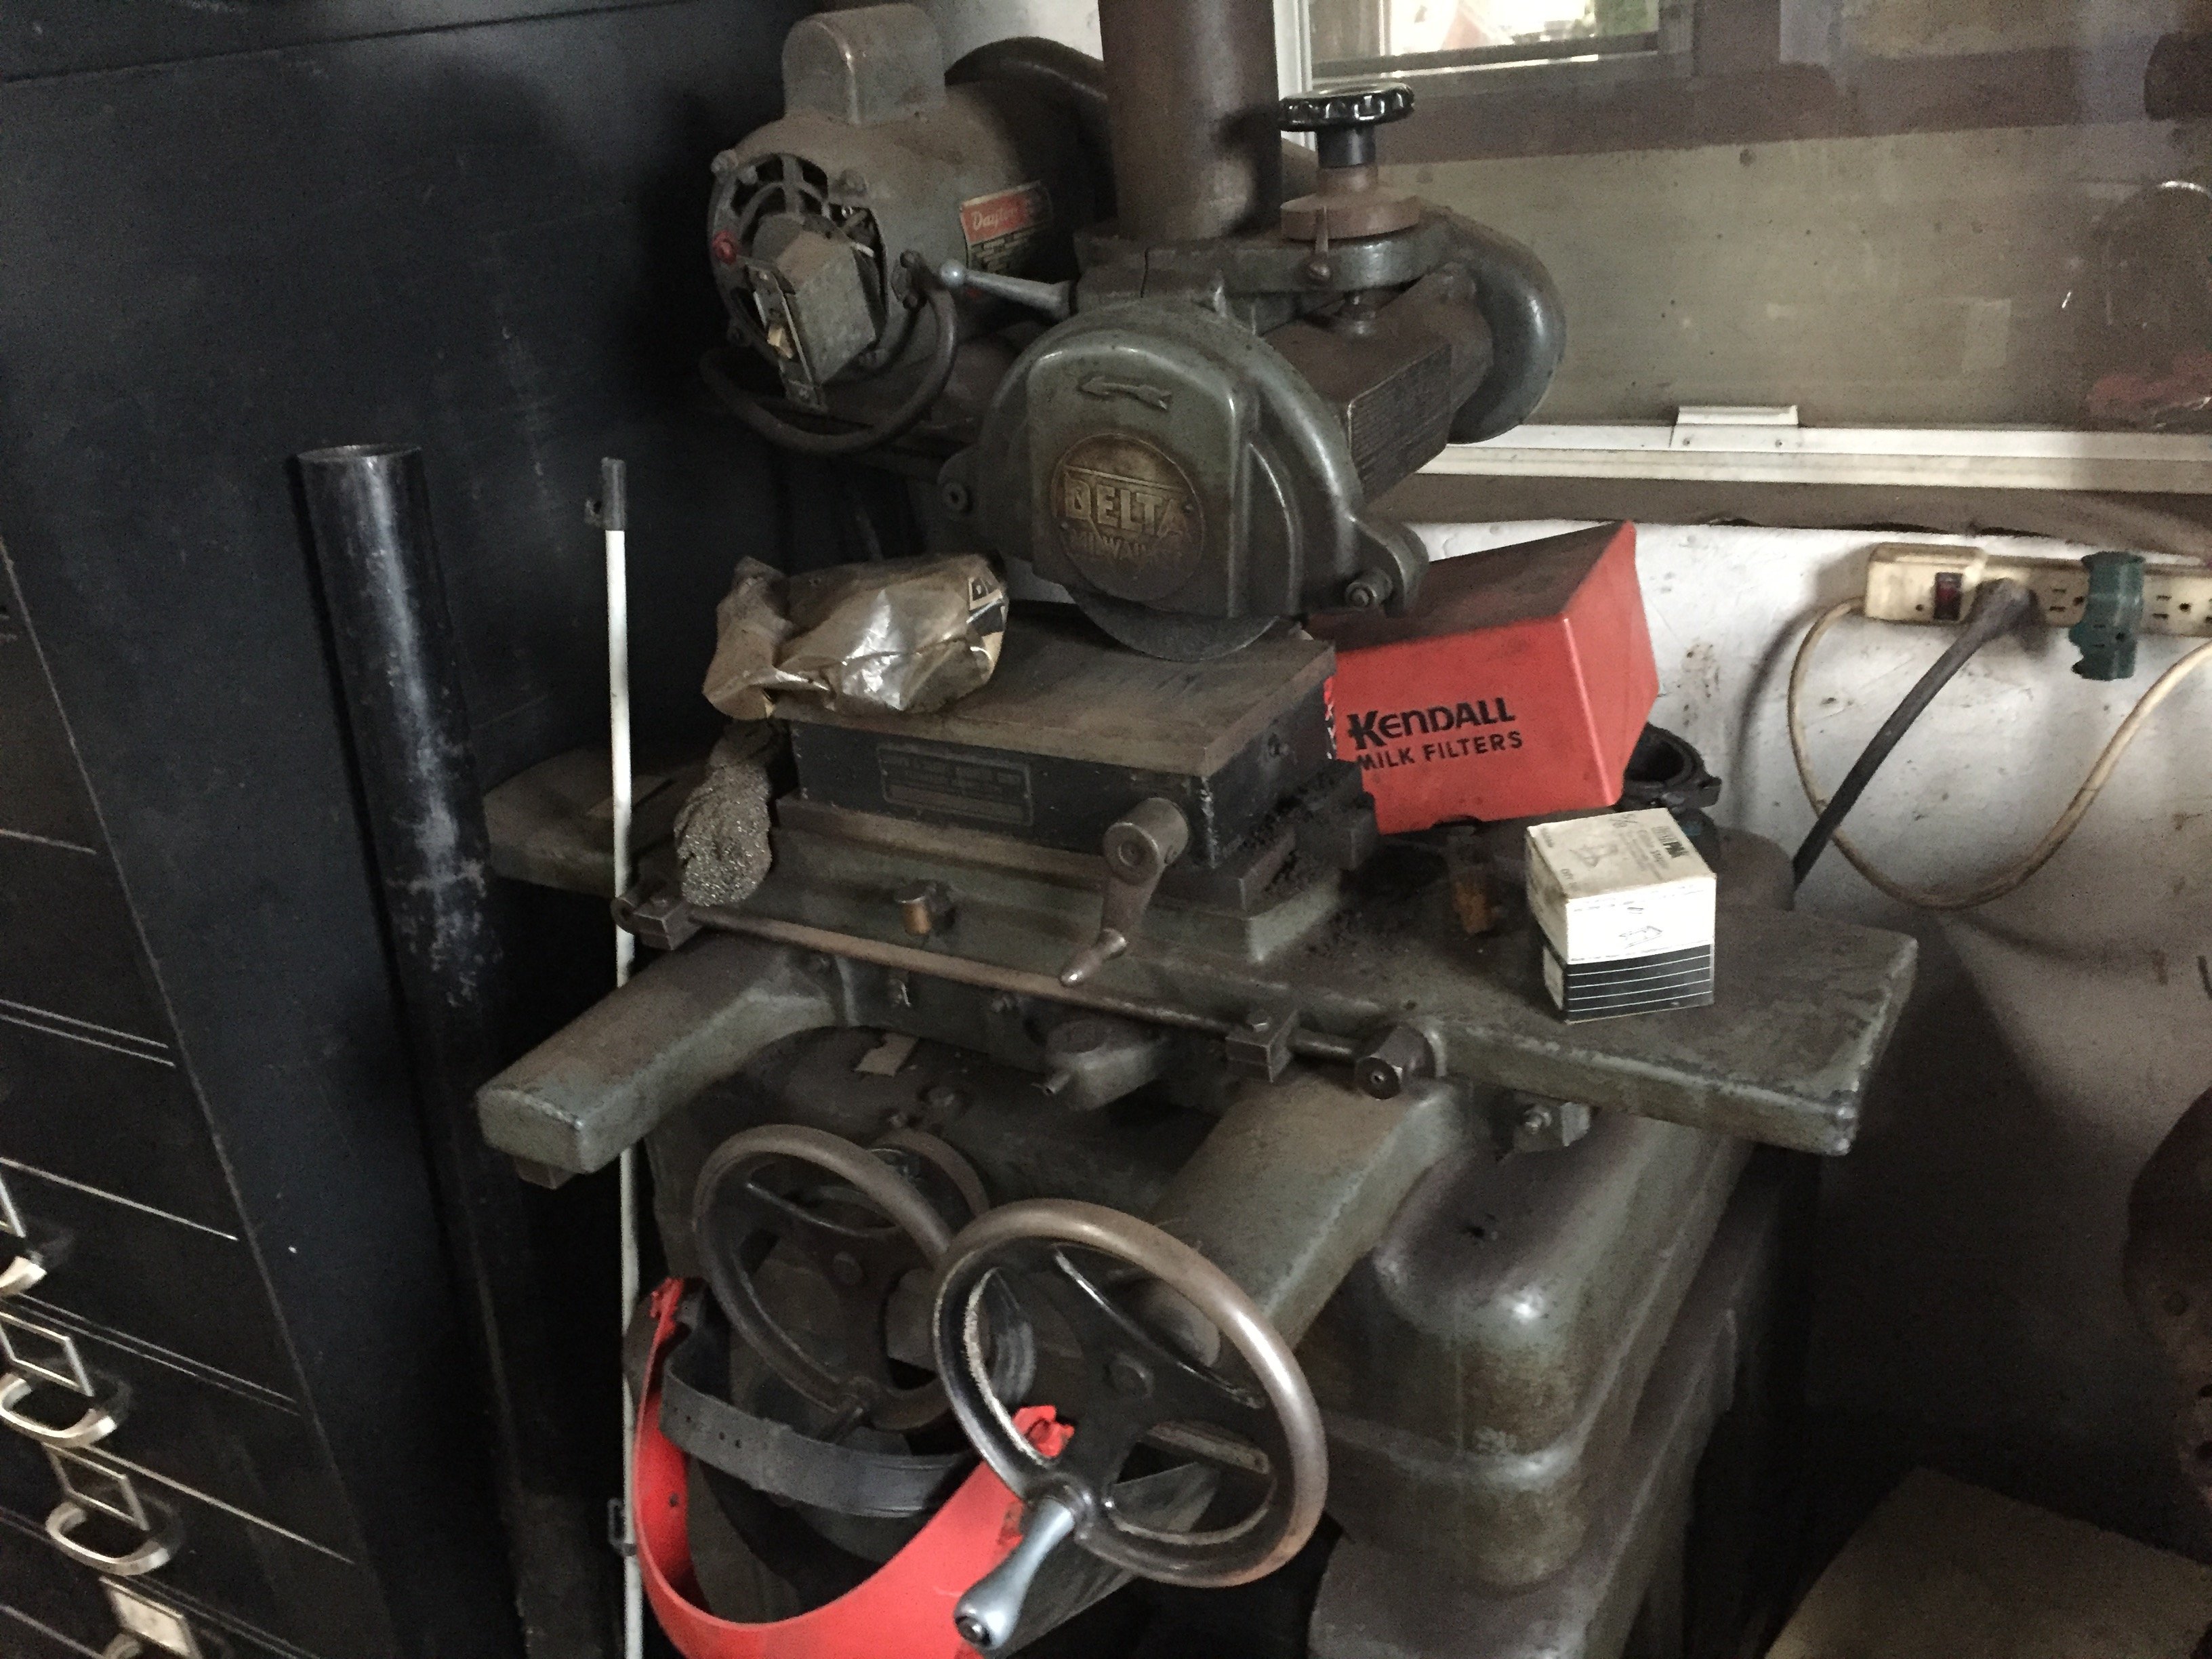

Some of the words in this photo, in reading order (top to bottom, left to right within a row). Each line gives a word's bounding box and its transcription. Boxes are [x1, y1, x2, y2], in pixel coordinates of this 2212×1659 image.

[1064, 476, 1186, 539] DELTA
[1356, 747, 1415, 777] MILK
[1422, 731, 1523, 769] FILTERS
